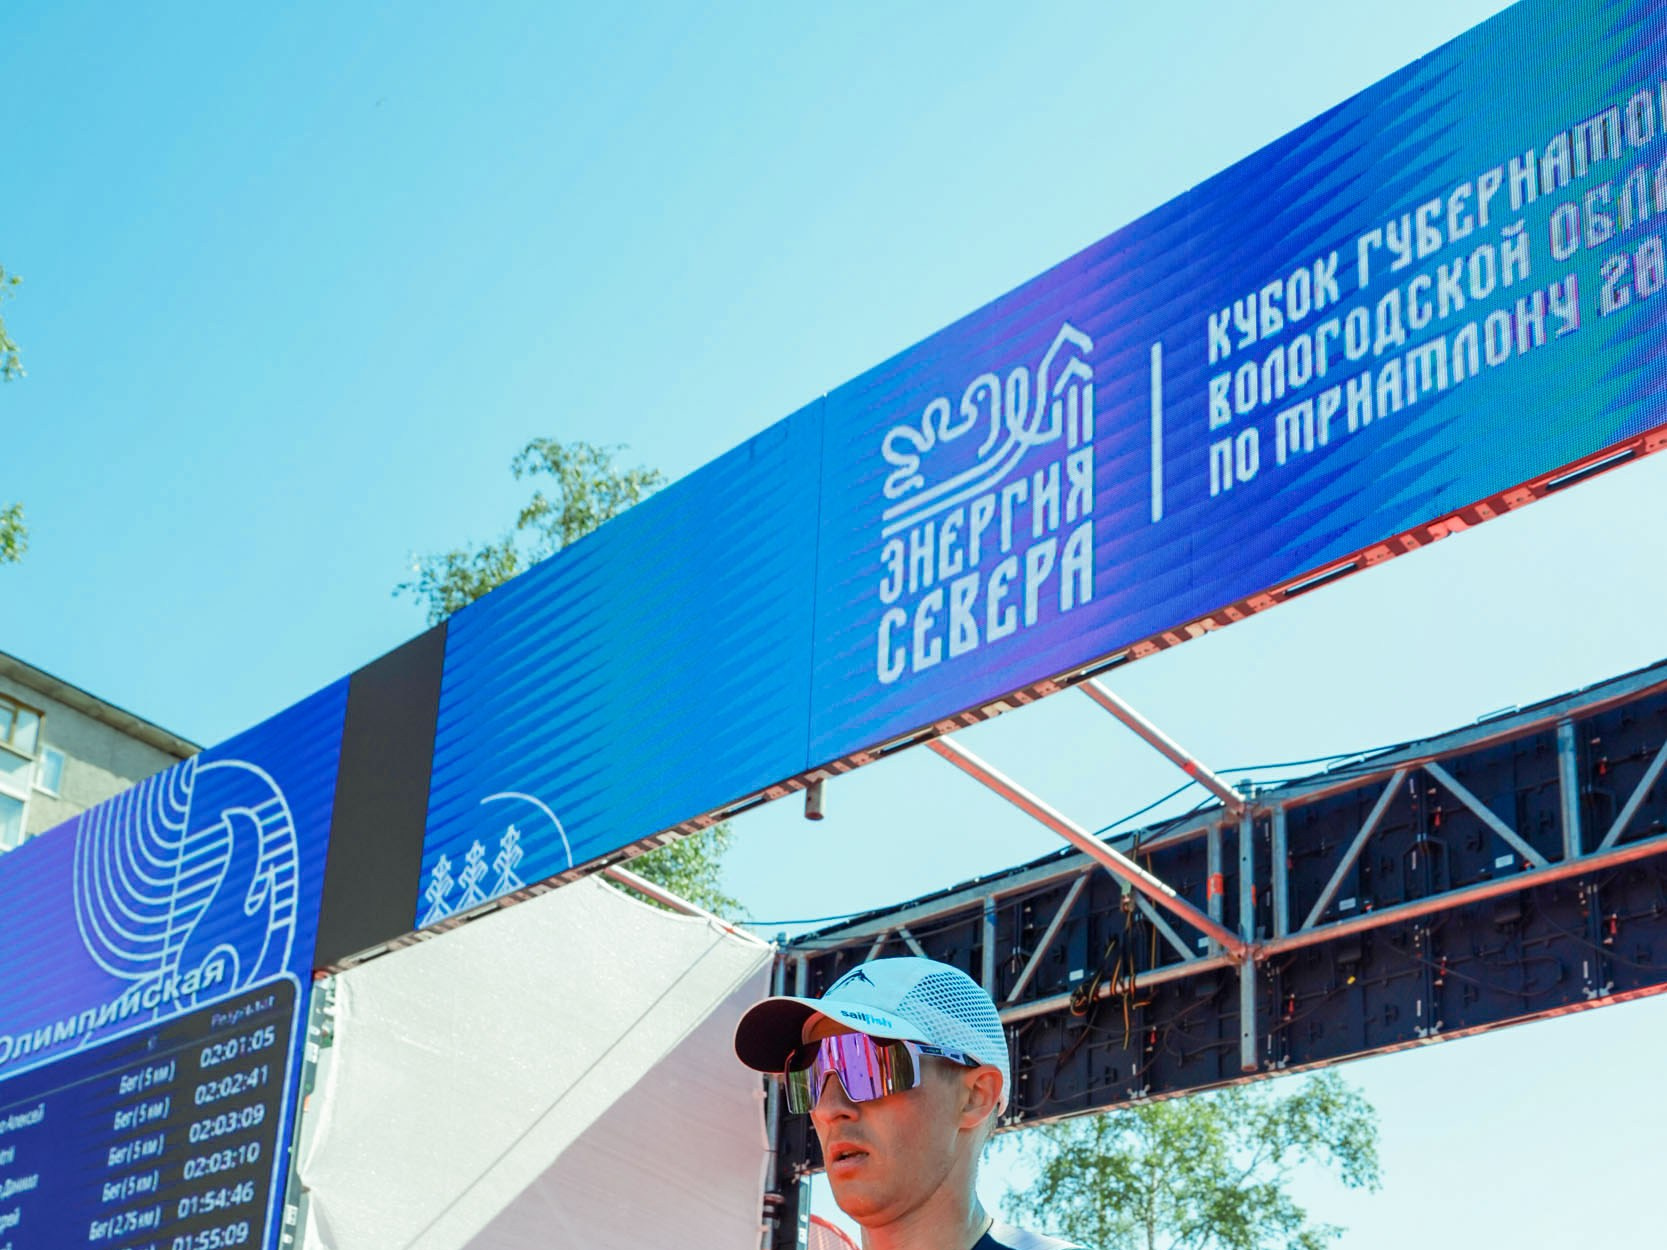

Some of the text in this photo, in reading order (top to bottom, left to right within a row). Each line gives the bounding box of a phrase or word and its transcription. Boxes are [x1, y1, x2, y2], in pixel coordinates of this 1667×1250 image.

[1208, 79, 1667, 366] КУБОК ГУБЕРНАТО
[1208, 218, 1531, 432] ВОЛОГОДСКОЙ
[1208, 427, 1260, 497] ПО
[879, 445, 1094, 604] ЭНЕРГИЯ
[876, 519, 1093, 685] СЕВЕРА
[0, 958, 225, 1066] Олимпийская
[200, 1025, 276, 1068] 02:01:05
[194, 1064, 268, 1105] 02:02:41
[188, 1103, 266, 1144] 02:03:09
[183, 1142, 261, 1181] 02:03:10
[177, 1181, 255, 1219] 01:54:46
